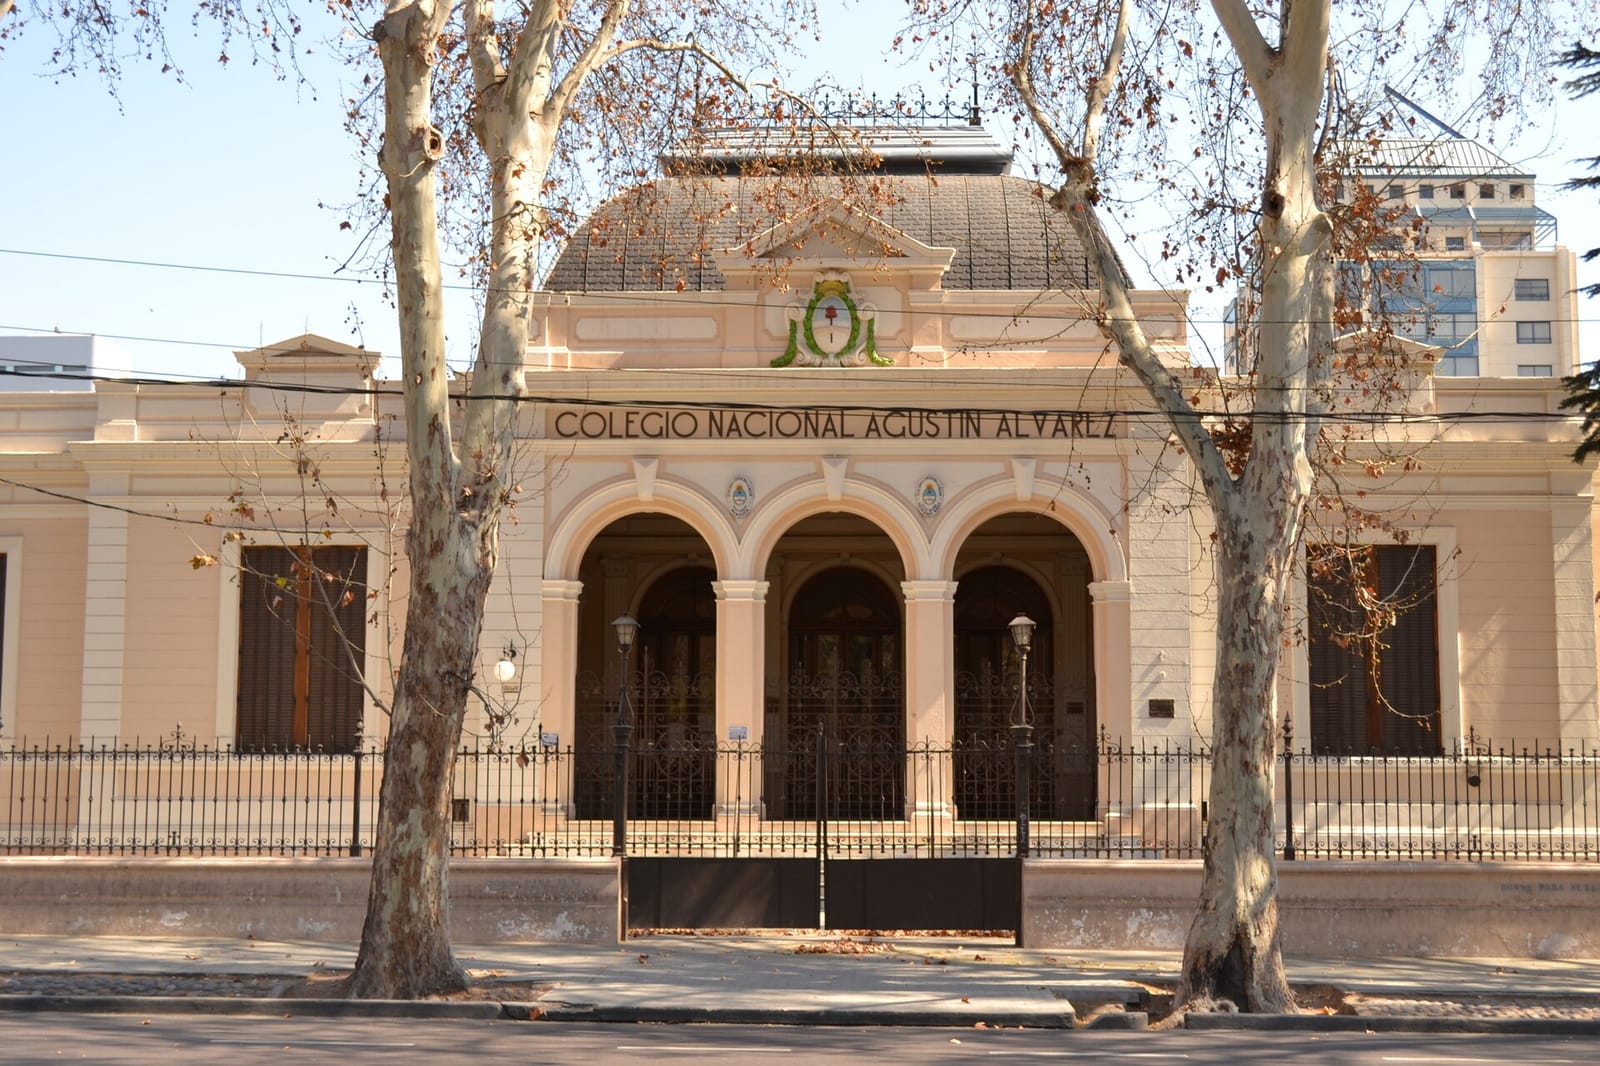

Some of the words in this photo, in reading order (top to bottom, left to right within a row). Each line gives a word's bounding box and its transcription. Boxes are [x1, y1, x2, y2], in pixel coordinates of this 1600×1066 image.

[555, 411, 698, 438] COLEGIO
[708, 410, 855, 438] NACIONAL
[865, 410, 981, 438] AGUSTIN
[996, 412, 1117, 438] ALVAREZ
